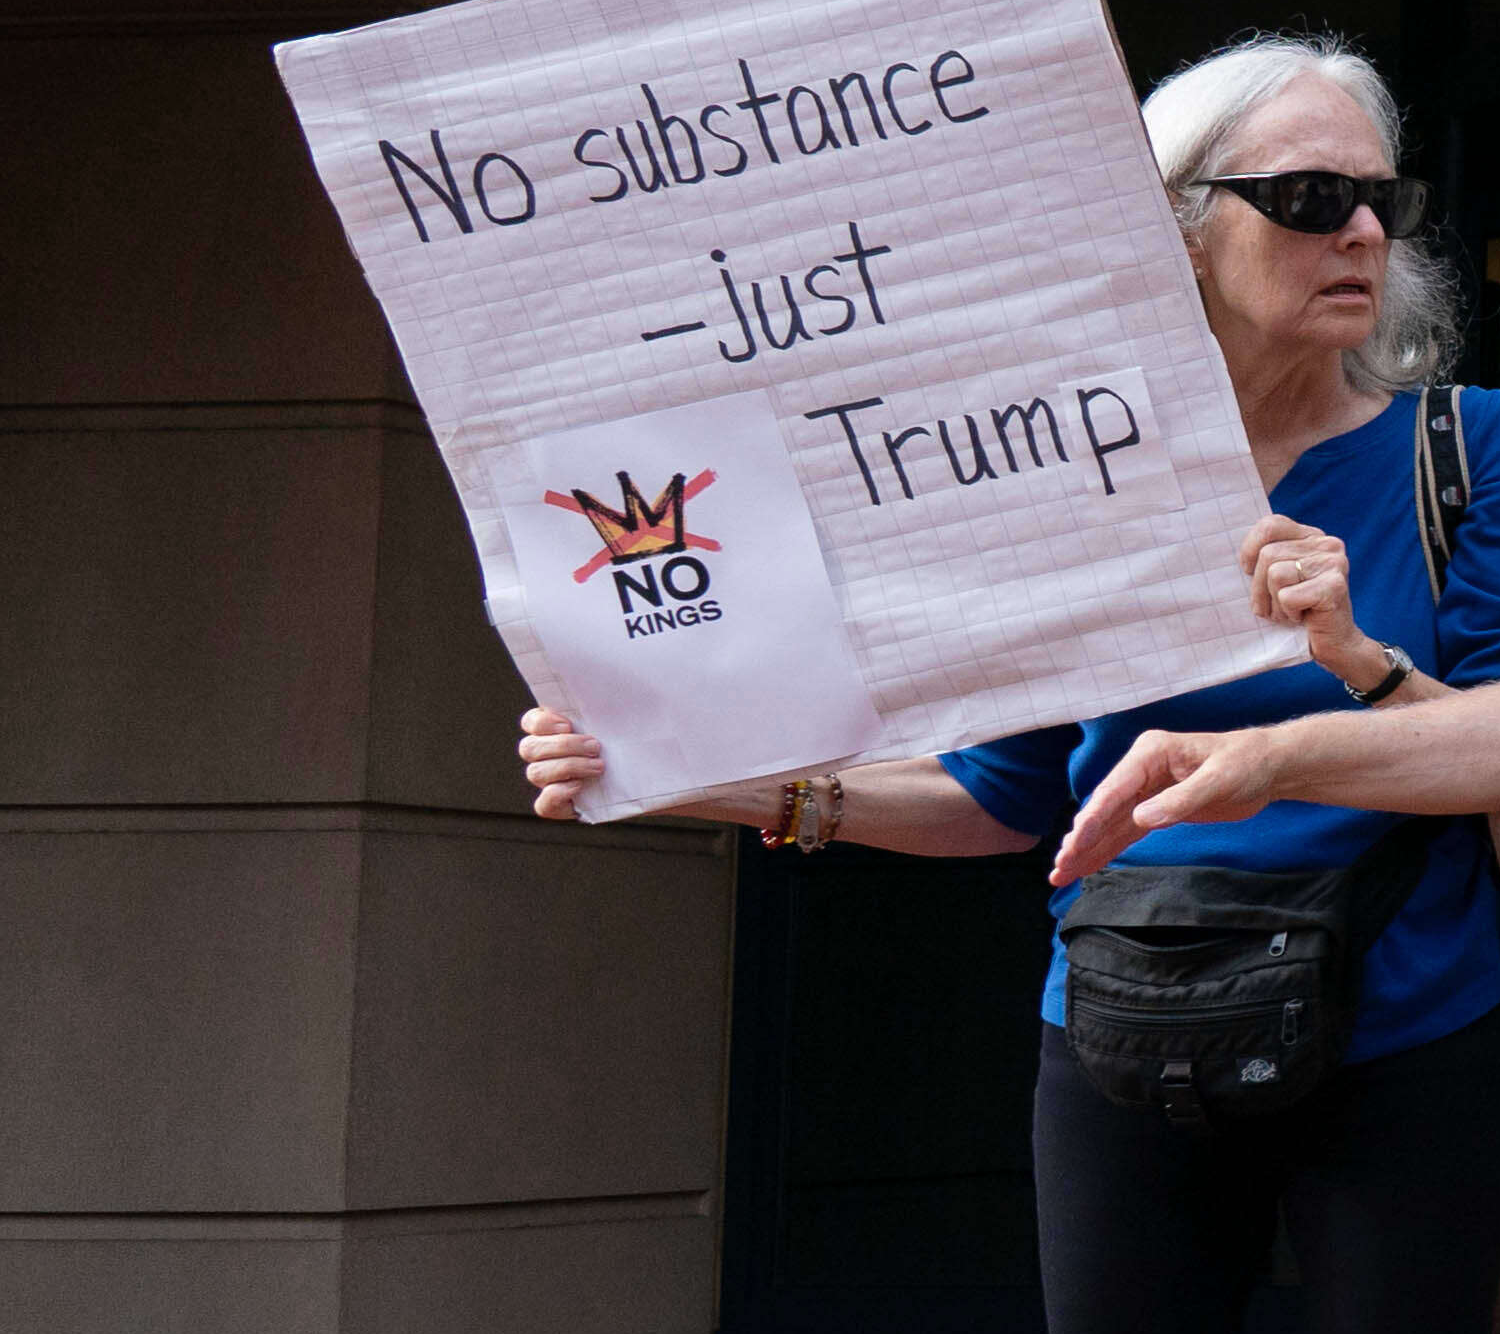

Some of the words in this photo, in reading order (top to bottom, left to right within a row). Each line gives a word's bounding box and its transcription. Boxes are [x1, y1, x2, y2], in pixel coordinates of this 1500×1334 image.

[378, 128, 536, 244] No
[573, 47, 990, 204] substance
[803, 383, 1142, 506] Trump
[612, 556, 711, 615] NO
[623, 599, 723, 640] KINGS
